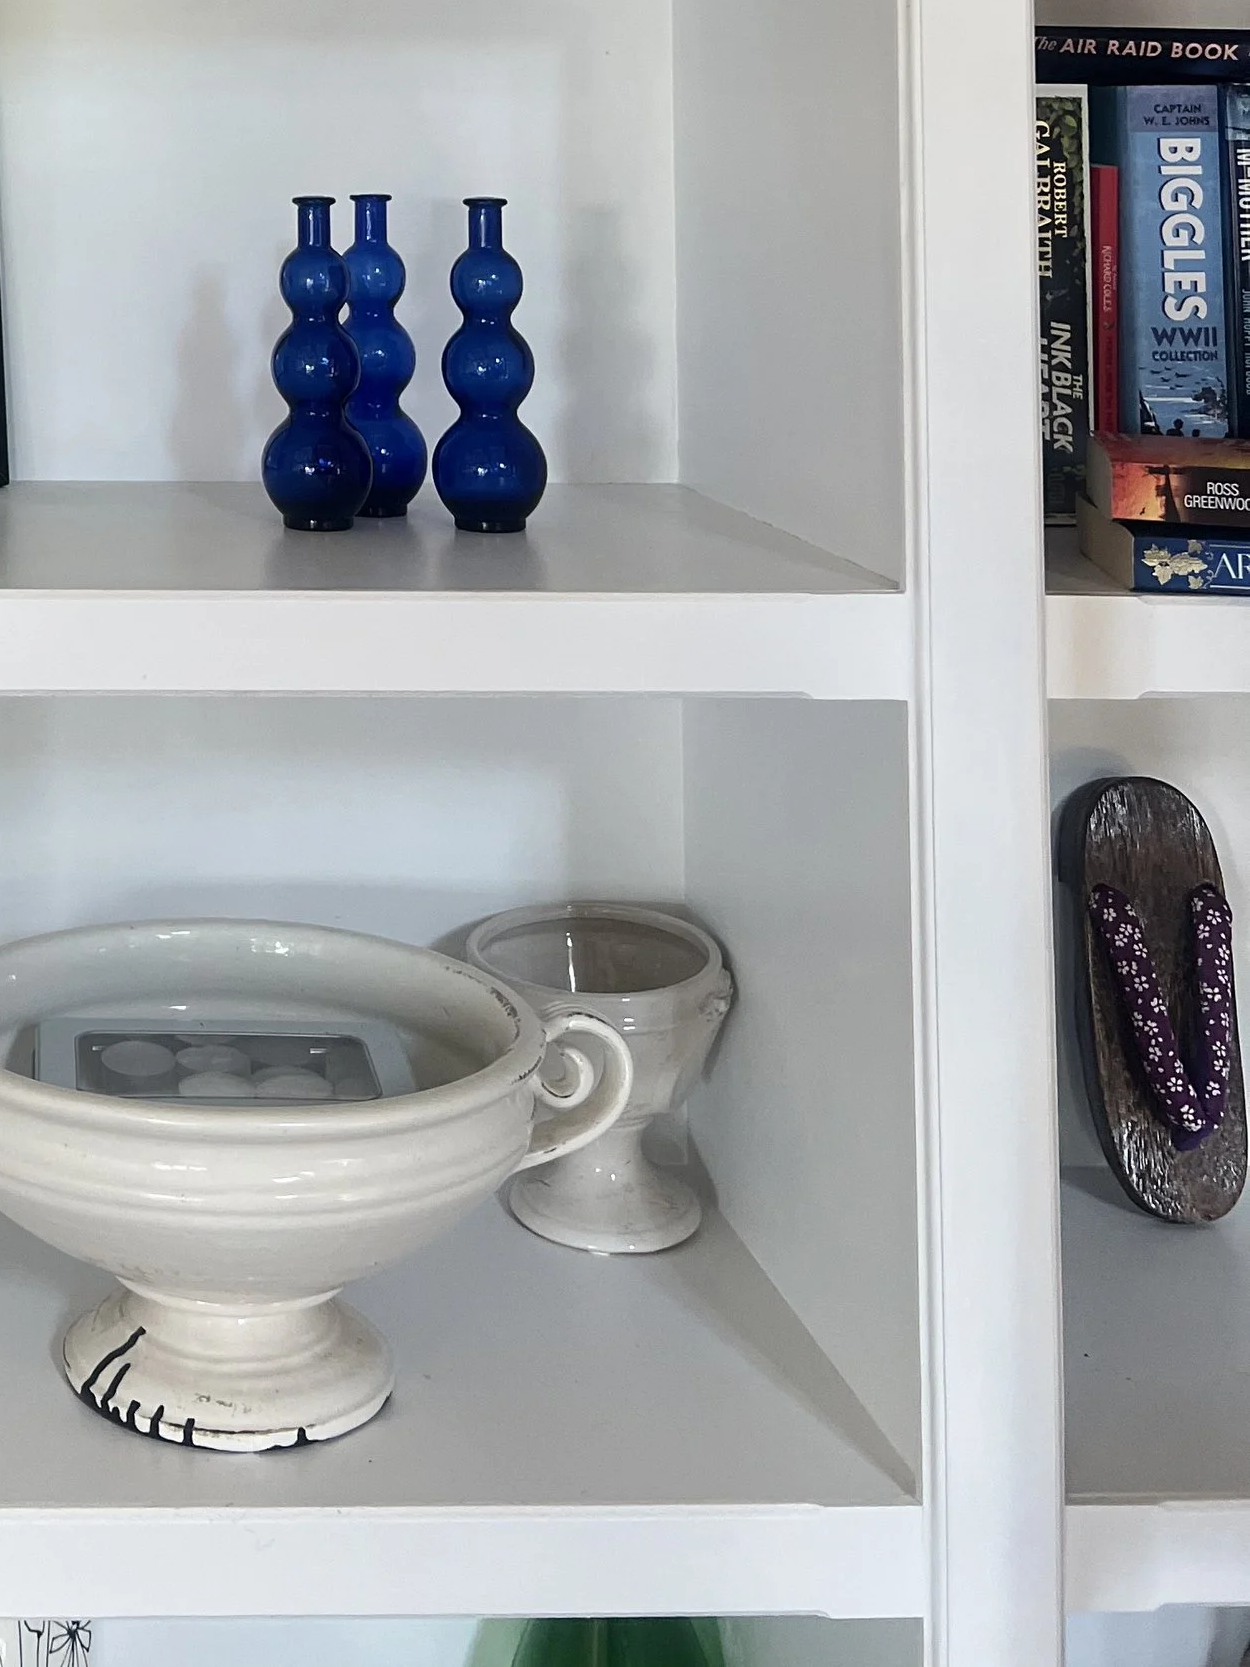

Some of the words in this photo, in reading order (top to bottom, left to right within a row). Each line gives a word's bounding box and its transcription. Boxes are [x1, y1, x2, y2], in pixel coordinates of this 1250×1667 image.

[1059, 38, 1097, 55] AIR
[1106, 39, 1162, 57] RAID
[1170, 42, 1239, 61] BOOK
[1144, 116, 1159, 126] W.
[1162, 116, 1171, 126] E.
[1175, 115, 1210, 126] JOHNS
[1153, 103, 1202, 114] CAPTAIN
[1053, 161, 1068, 238] ROBERT
[1158, 137, 1208, 322] BIGGLES
[1102, 245, 1112, 283] RICHARD
[1050, 321, 1072, 369] INK
[1151, 326, 1218, 348] WWII
[1151, 350, 1218, 362] COLLECTION
[1072, 374, 1084, 400] THE
[1051, 371, 1074, 453] BLACK
[1207, 482, 1240, 497] ROSS
